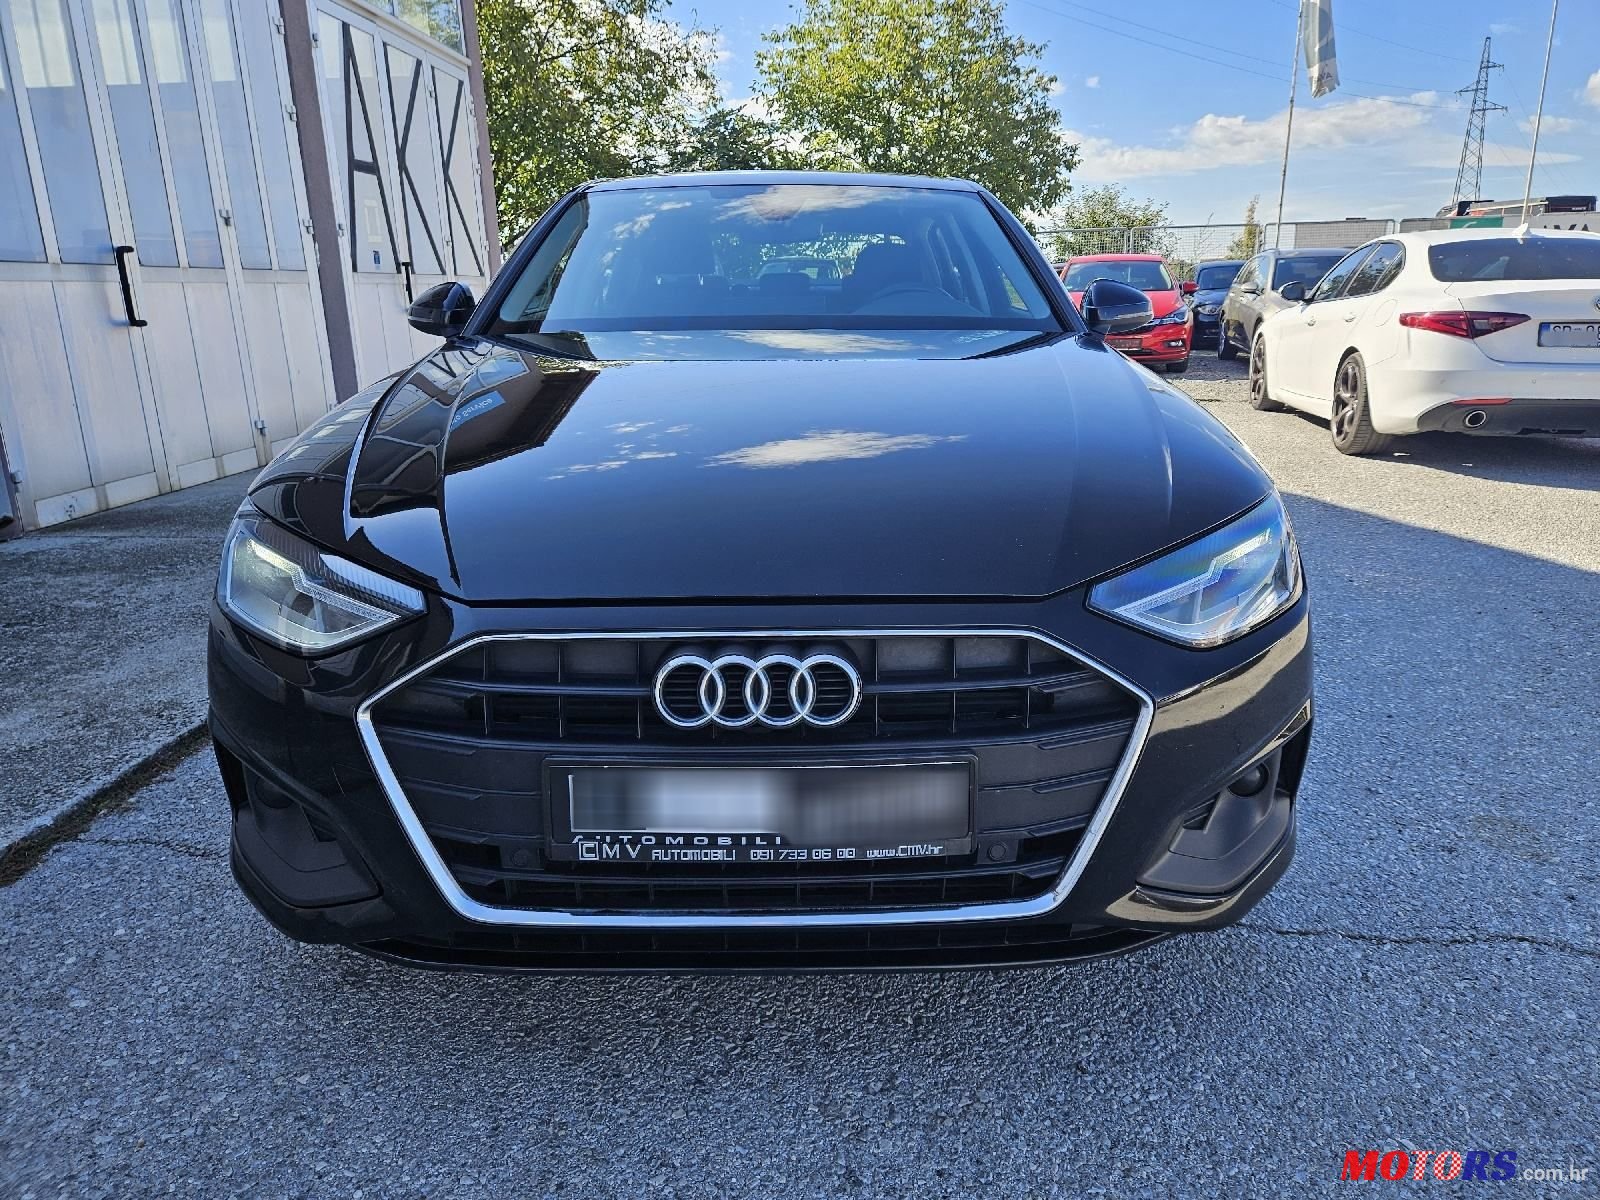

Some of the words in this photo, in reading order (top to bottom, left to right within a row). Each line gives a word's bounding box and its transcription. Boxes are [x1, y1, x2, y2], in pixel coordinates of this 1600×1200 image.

[652, 849, 736, 861] AUTOMOBILI
[750, 849, 774, 860] 091
[778, 849, 808, 860] 733
[812, 848, 832, 860] 06
